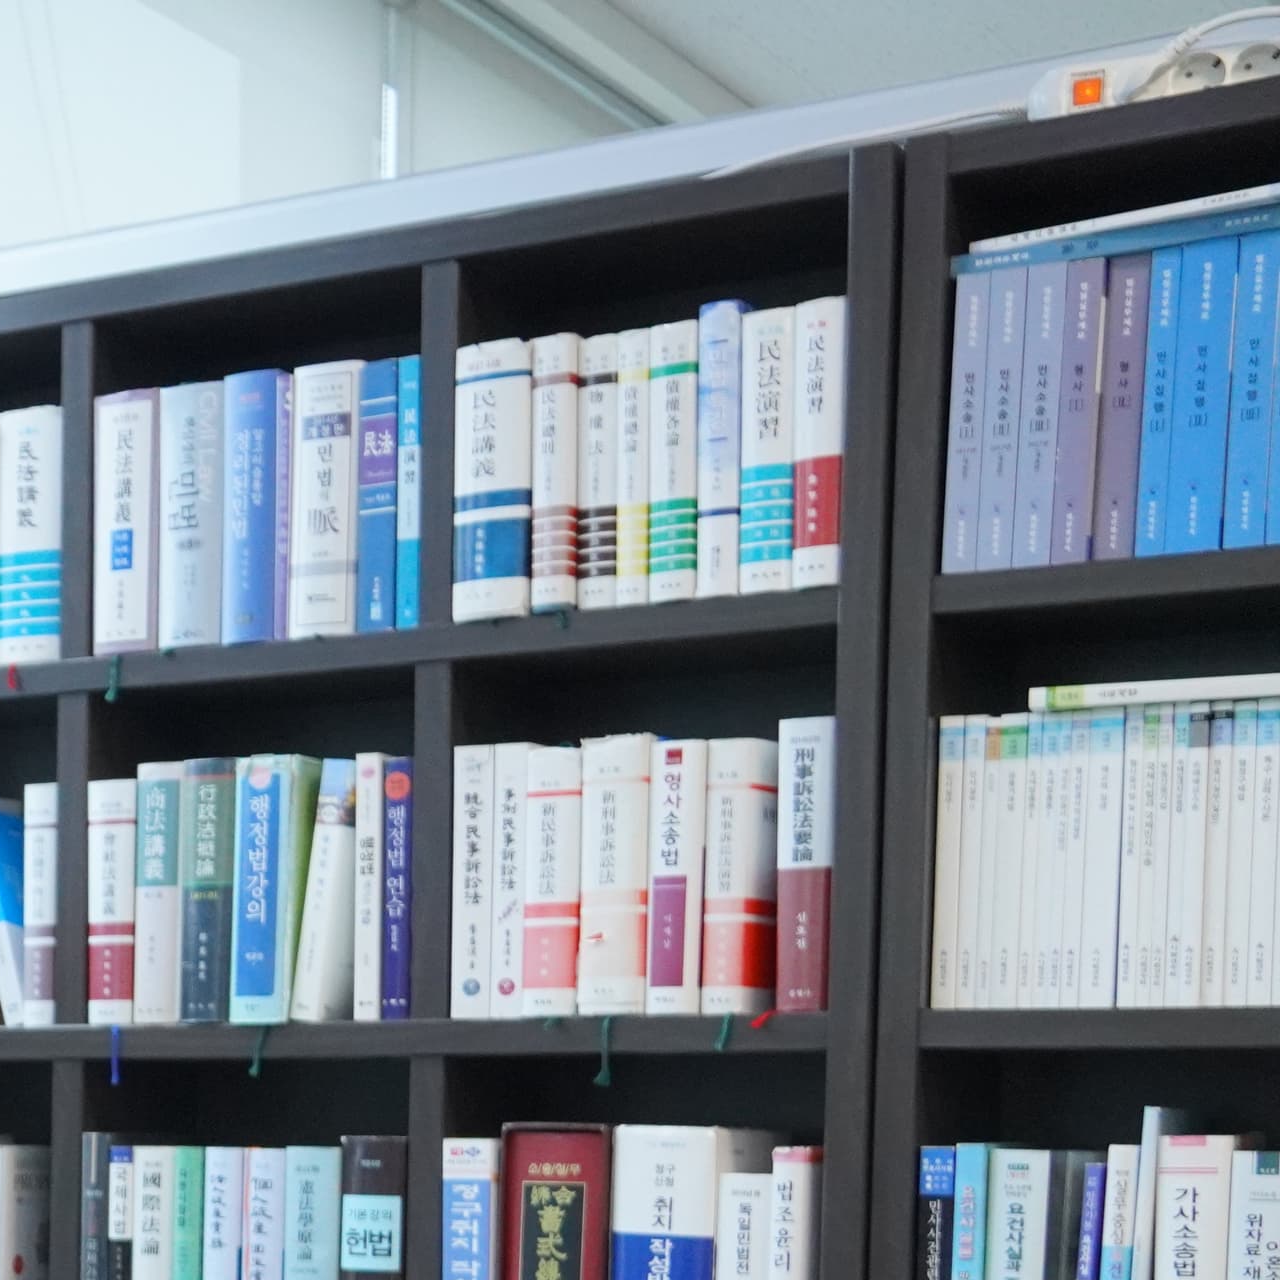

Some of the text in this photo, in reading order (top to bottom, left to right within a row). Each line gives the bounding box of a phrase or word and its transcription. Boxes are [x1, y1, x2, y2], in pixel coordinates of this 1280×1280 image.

[997, 368, 1011, 421] 민사소송
[1034, 364, 1049, 417] 민사소송
[362, 430, 393, 457] 民法
[471, 388, 496, 478] 民法講義
[114, 428, 135, 525] 民法講義
[143, 785, 167, 881] 商法講義
[660, 773, 683, 867] 형사소송법
[792, 747, 816, 863] 刑事訴訟法要論
[246, 795, 271, 926] 행정법강의
[385, 805, 406, 920] 행정법 연습
[464, 824, 483, 905] 民事訴訟法
[655, 1163, 677, 1175] 청구
[141, 1171, 162, 1256] 國際法論
[345, 1228, 393, 1257] 헌법
[450, 1183, 483, 1255] 청구취지
[651, 1196, 674, 1231] 취지
[735, 1202, 753, 1276] 독일민법전
[773, 1181, 795, 1272] 법조윤리
[1004, 1202, 1026, 1273] 요건사실과
[1172, 1186, 1201, 1278] 가사소송법
